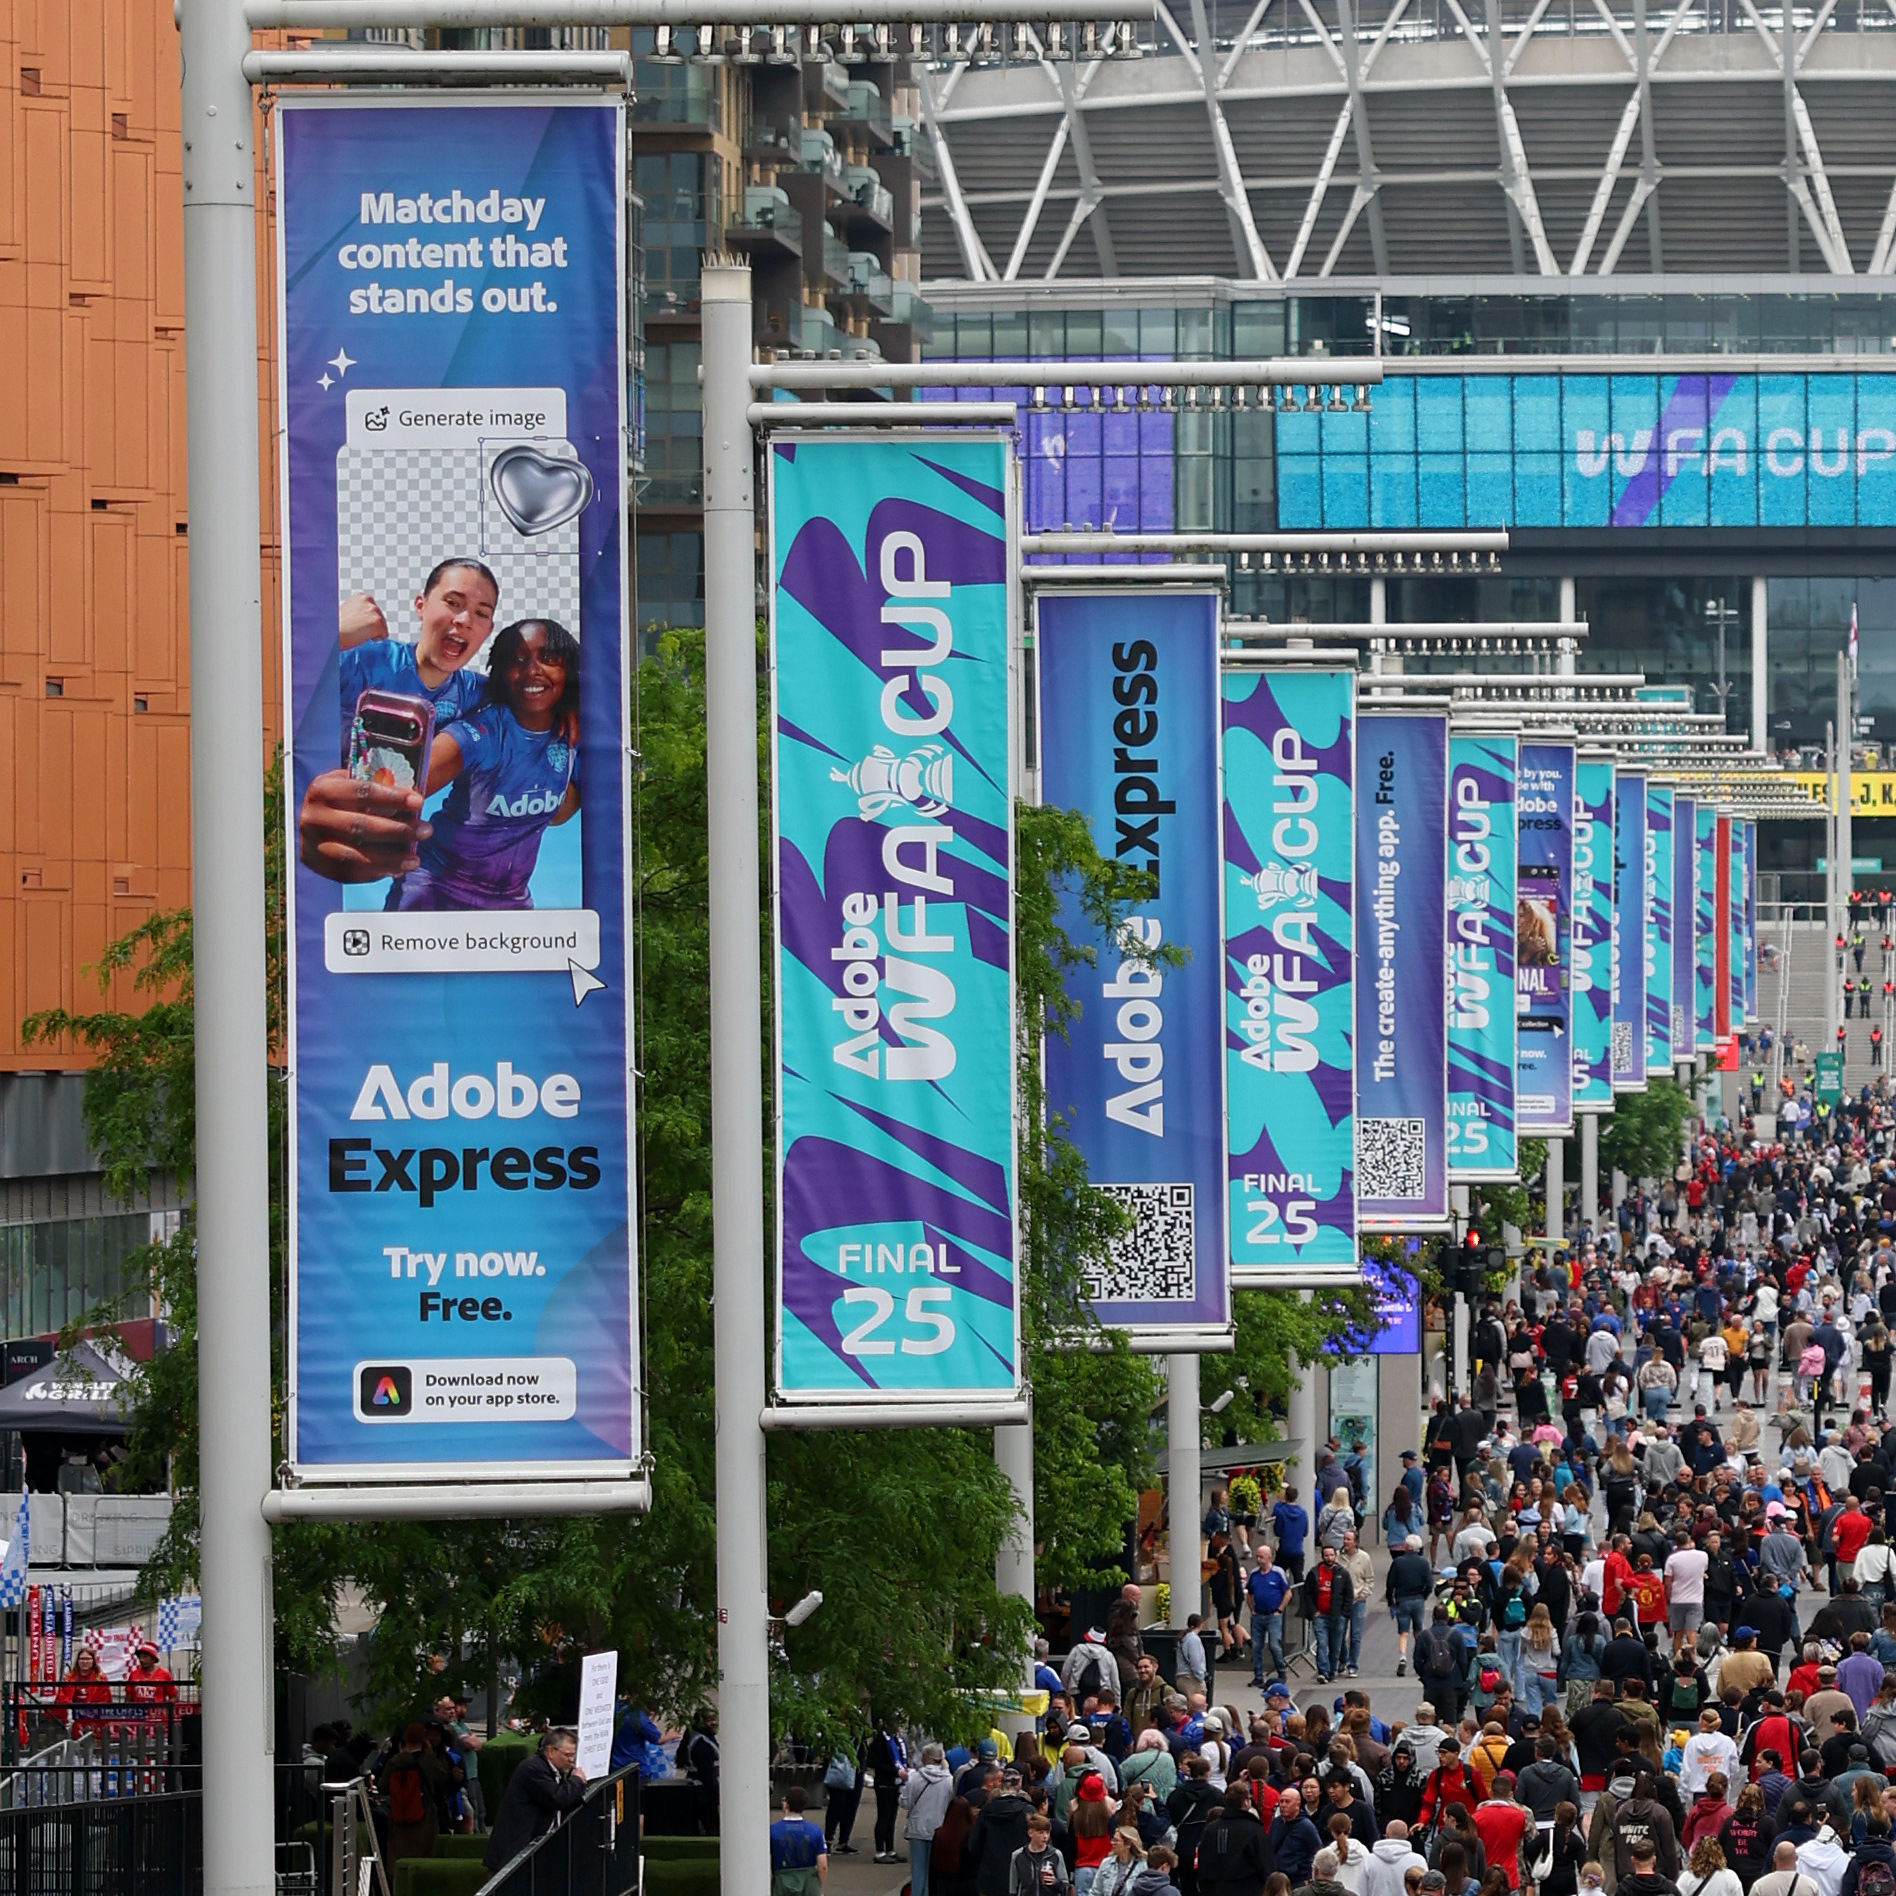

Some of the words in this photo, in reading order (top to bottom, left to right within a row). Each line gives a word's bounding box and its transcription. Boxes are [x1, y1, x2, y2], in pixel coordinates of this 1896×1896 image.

[360, 189, 546, 231] Matchday
[338, 237, 483, 269] content
[489, 234, 568, 268] that
[350, 279, 474, 314] stands
[482, 281, 557, 313] out.
[398, 407, 486, 428] Generate
[490, 407, 546, 431] image
[879, 529, 953, 737] CUP
[1111, 638, 1177, 900] Express
[1375, 751, 1395, 804] Free.
[1523, 767, 1535, 780] by
[1538, 768, 1562, 780] you.
[1531, 780, 1555, 791] with
[1273, 727, 1320, 858] CUP
[1517, 797, 1557, 813] dobe
[1860, 782, 1877, 807] J,
[1380, 810, 1400, 854] app.
[1456, 777, 1491, 872] CUP
[1518, 818, 1561, 832] press
[381, 934, 459, 951] Remove
[466, 932, 577, 959] background
[1373, 857, 1400, 1034] create-anything
[832, 892, 880, 1078] Adobe
[1102, 915, 1164, 1138] Adobe
[1240, 953, 1271, 1071] Adobe
[1374, 1037, 1396, 1082] The
[1520, 1050, 1547, 1059] now.
[350, 1061, 581, 1121] Adobe
[329, 1138, 601, 1208] Express
[1243, 1173, 1322, 1194] FINAL
[1245, 1201, 1320, 1245] 25
[383, 1246, 447, 1286] Try
[455, 1250, 546, 1278] now.
[837, 1241, 961, 1275] FINAL
[419, 1291, 512, 1322] Free.
[841, 1286, 958, 1356] 25
[10, 1355, 38, 1364] ARCH
[426, 1373, 504, 1387] Download
[506, 1373, 539, 1387] now
[1569, 1384, 1578, 1398] 7
[426, 1392, 447, 1406] on
[449, 1392, 483, 1408] your
[486, 1391, 514, 1408] app
[516, 1390, 560, 1405] store.
[1620, 1824, 1649, 1835] WHITE
[1626, 1835, 1644, 1845] FOX
